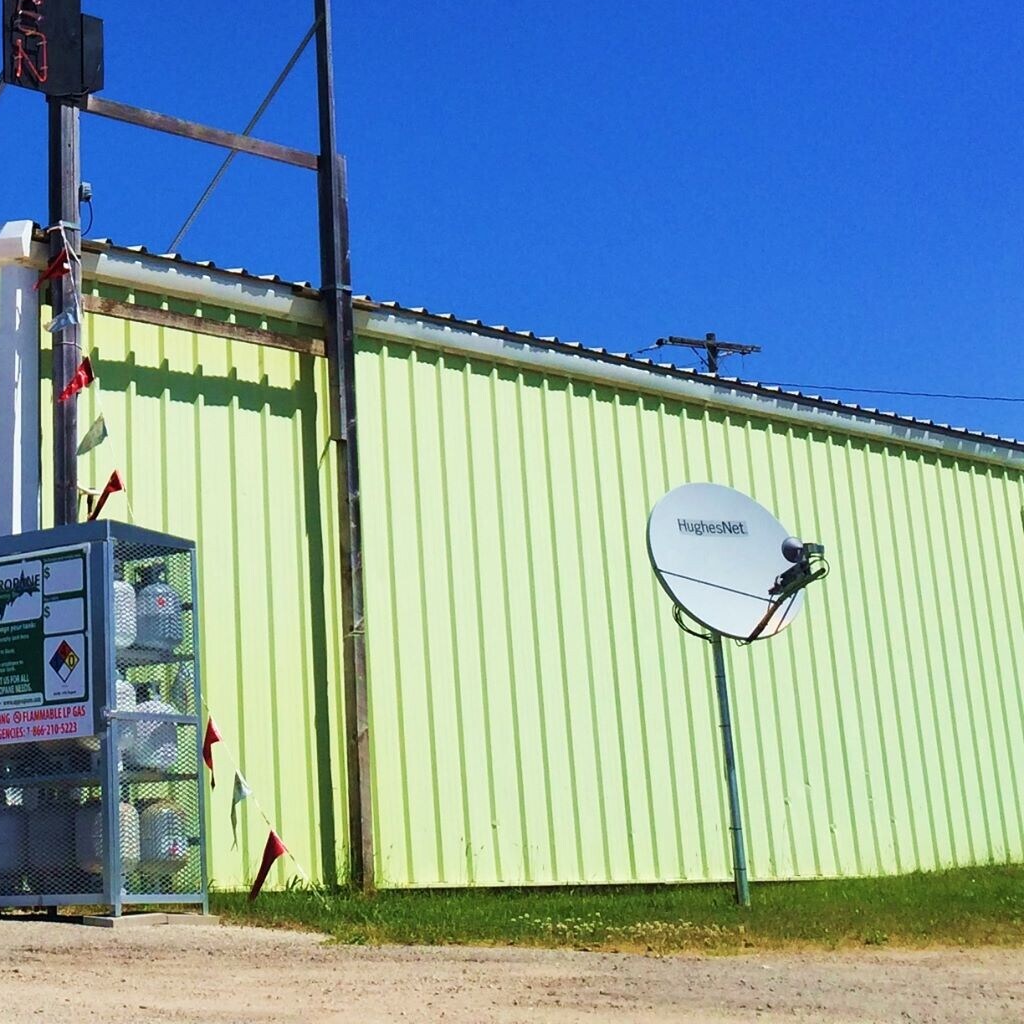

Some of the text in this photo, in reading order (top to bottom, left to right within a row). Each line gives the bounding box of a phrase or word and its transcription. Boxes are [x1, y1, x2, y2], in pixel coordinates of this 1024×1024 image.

[676, 518, 746, 536] HughesNet
[22, 707, 62, 722] FLAMMABLE
[62, 707, 71, 718] LP
[72, 705, 86, 717] GAS
